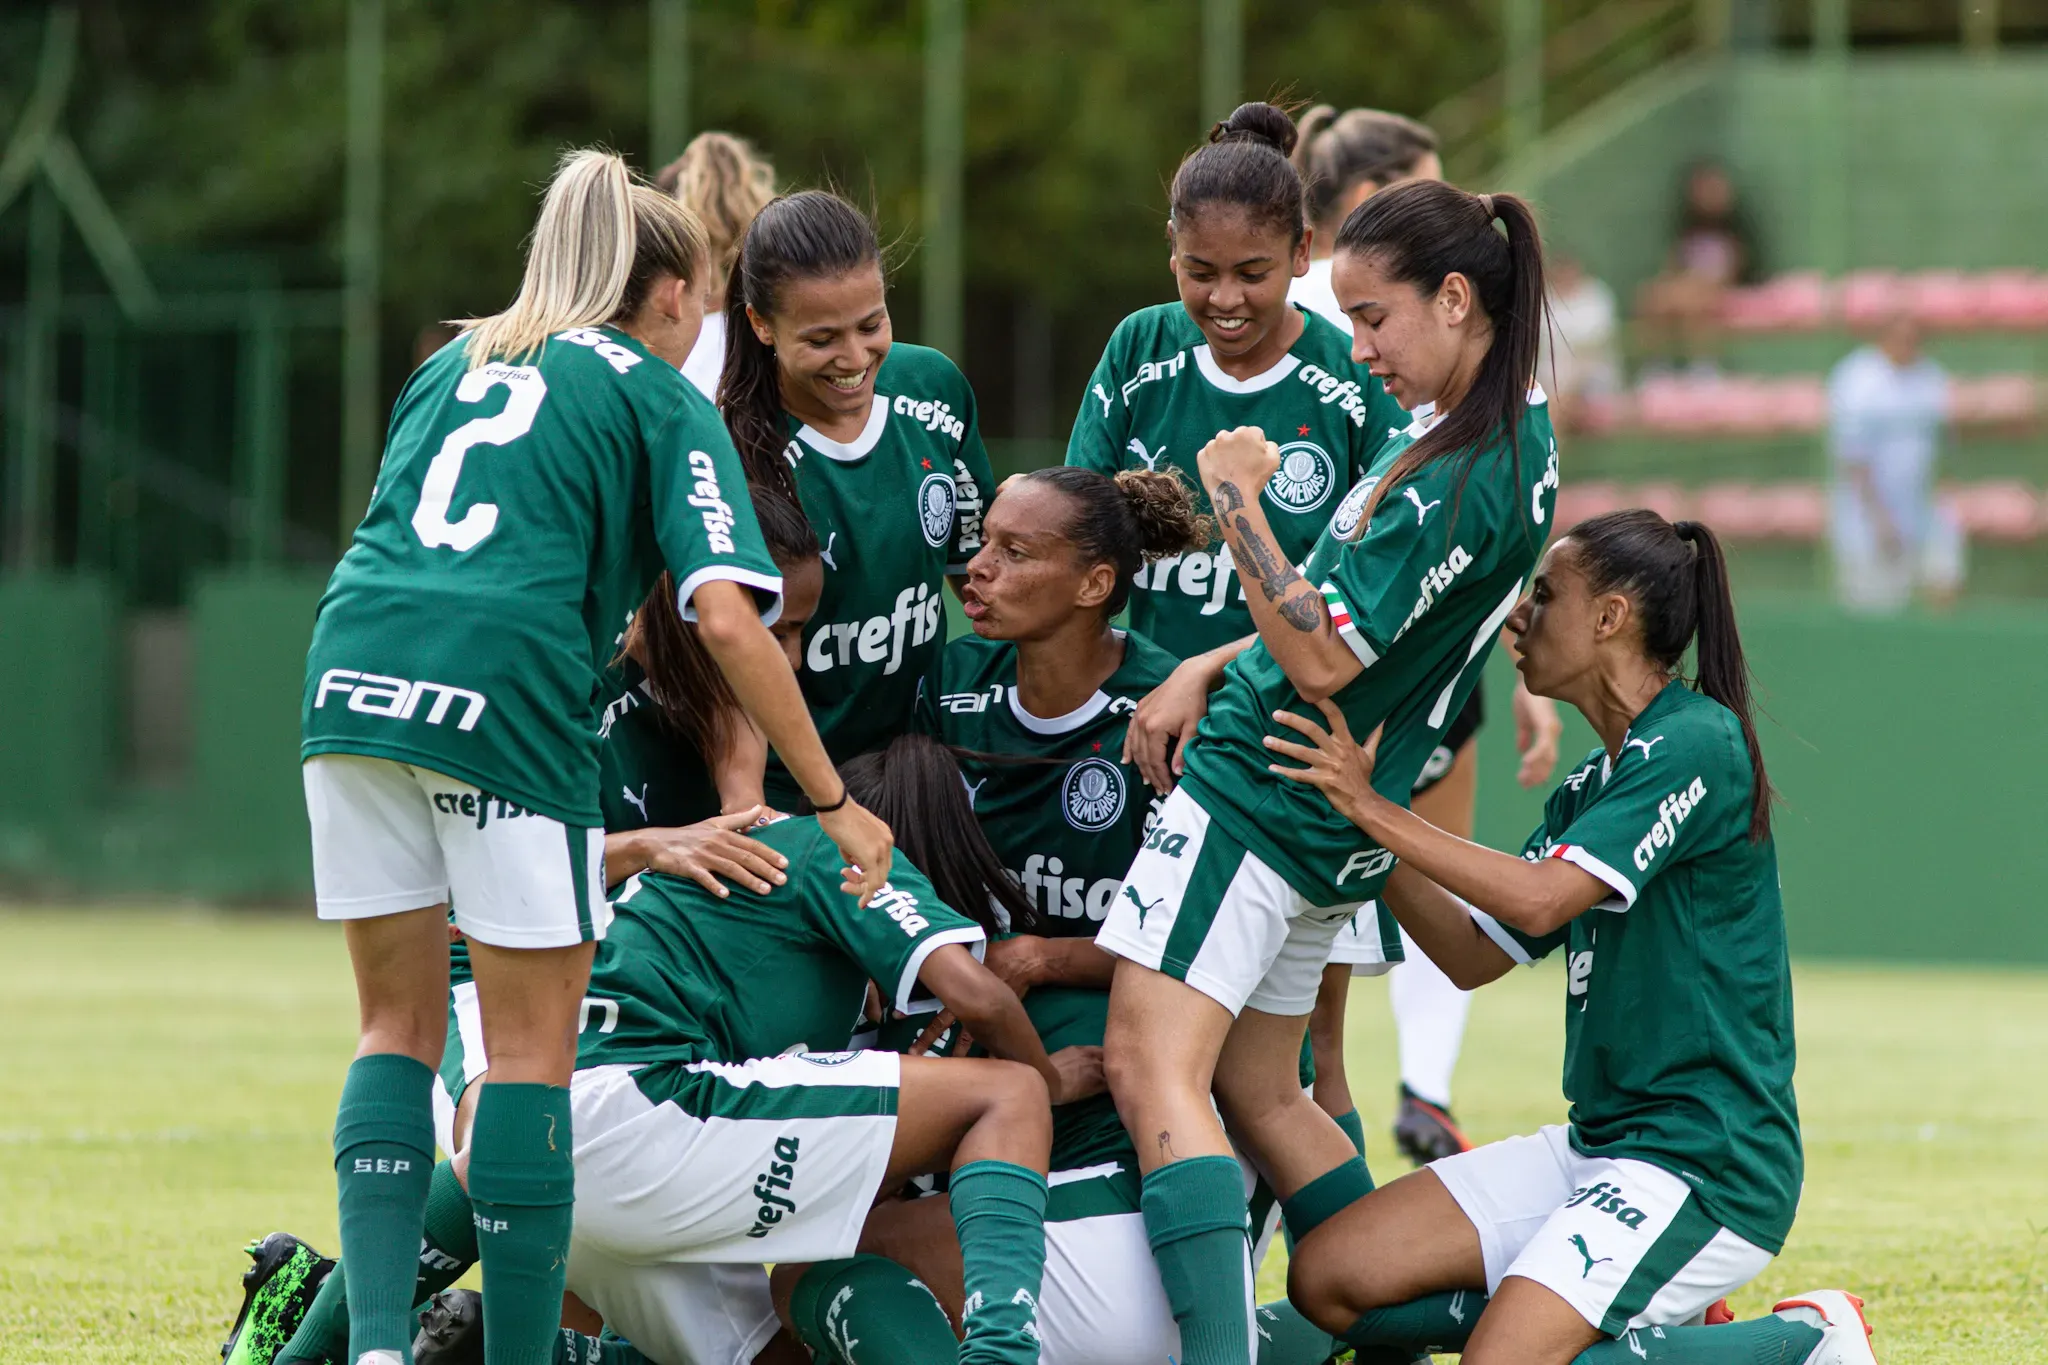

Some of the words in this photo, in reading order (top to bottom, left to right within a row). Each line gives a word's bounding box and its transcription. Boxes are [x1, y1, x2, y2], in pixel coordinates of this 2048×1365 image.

[485, 367, 531, 381] crefisa
[1298, 364, 1367, 428] crefisa
[893, 395, 965, 442] crefisa
[411, 361, 548, 552] 2
[687, 450, 736, 554] crefisa
[953, 458, 984, 553] crefisa
[1271, 470, 1326, 504] PALMEIRAS
[1392, 545, 1474, 644] crefisa
[807, 582, 942, 676] crefis
[1069, 790, 1118, 823] PALMEIRAS
[1633, 776, 1708, 872] crefisa
[1336, 848, 1399, 886] Fa
[353, 1158, 411, 1175] SEP
[473, 1211, 509, 1234] SEP
